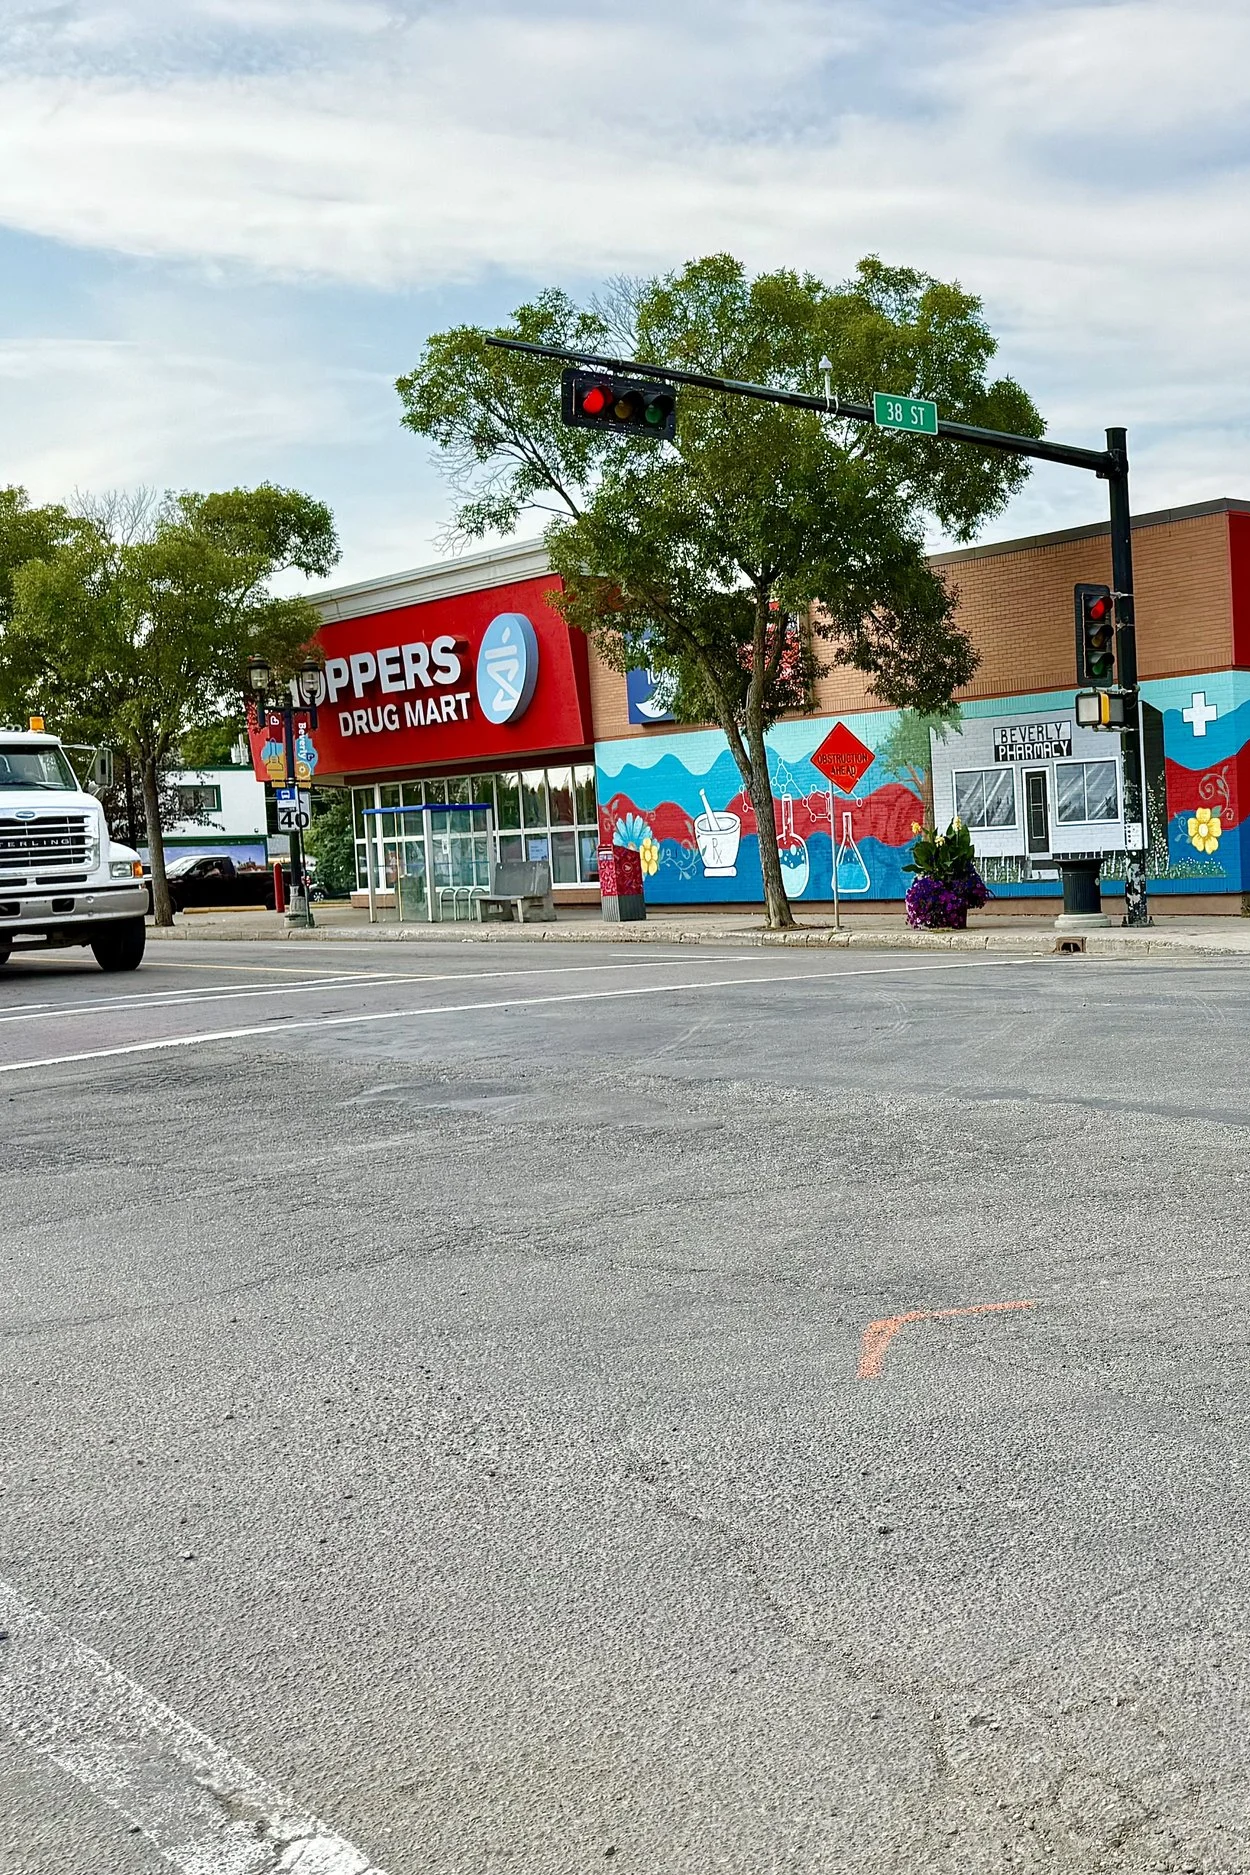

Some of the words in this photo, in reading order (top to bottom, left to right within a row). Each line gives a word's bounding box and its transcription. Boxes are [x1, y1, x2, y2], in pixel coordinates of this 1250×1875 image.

[887, 401, 903, 422] 38
[911, 405, 925, 426] ST
[290, 635, 462, 708] OPPERS
[338, 703, 400, 737] DRUG
[404, 692, 472, 729] MART
[298, 722, 308, 760] Beverly
[1000, 723, 1062, 744] BEVERLY
[817, 752, 868, 764] OBSTRUCTION
[998, 740, 1069, 762] PHARMACY
[831, 764, 857, 777] AHEAD
[280, 812, 310, 829] 40
[0, 838, 70, 848] TERLING
